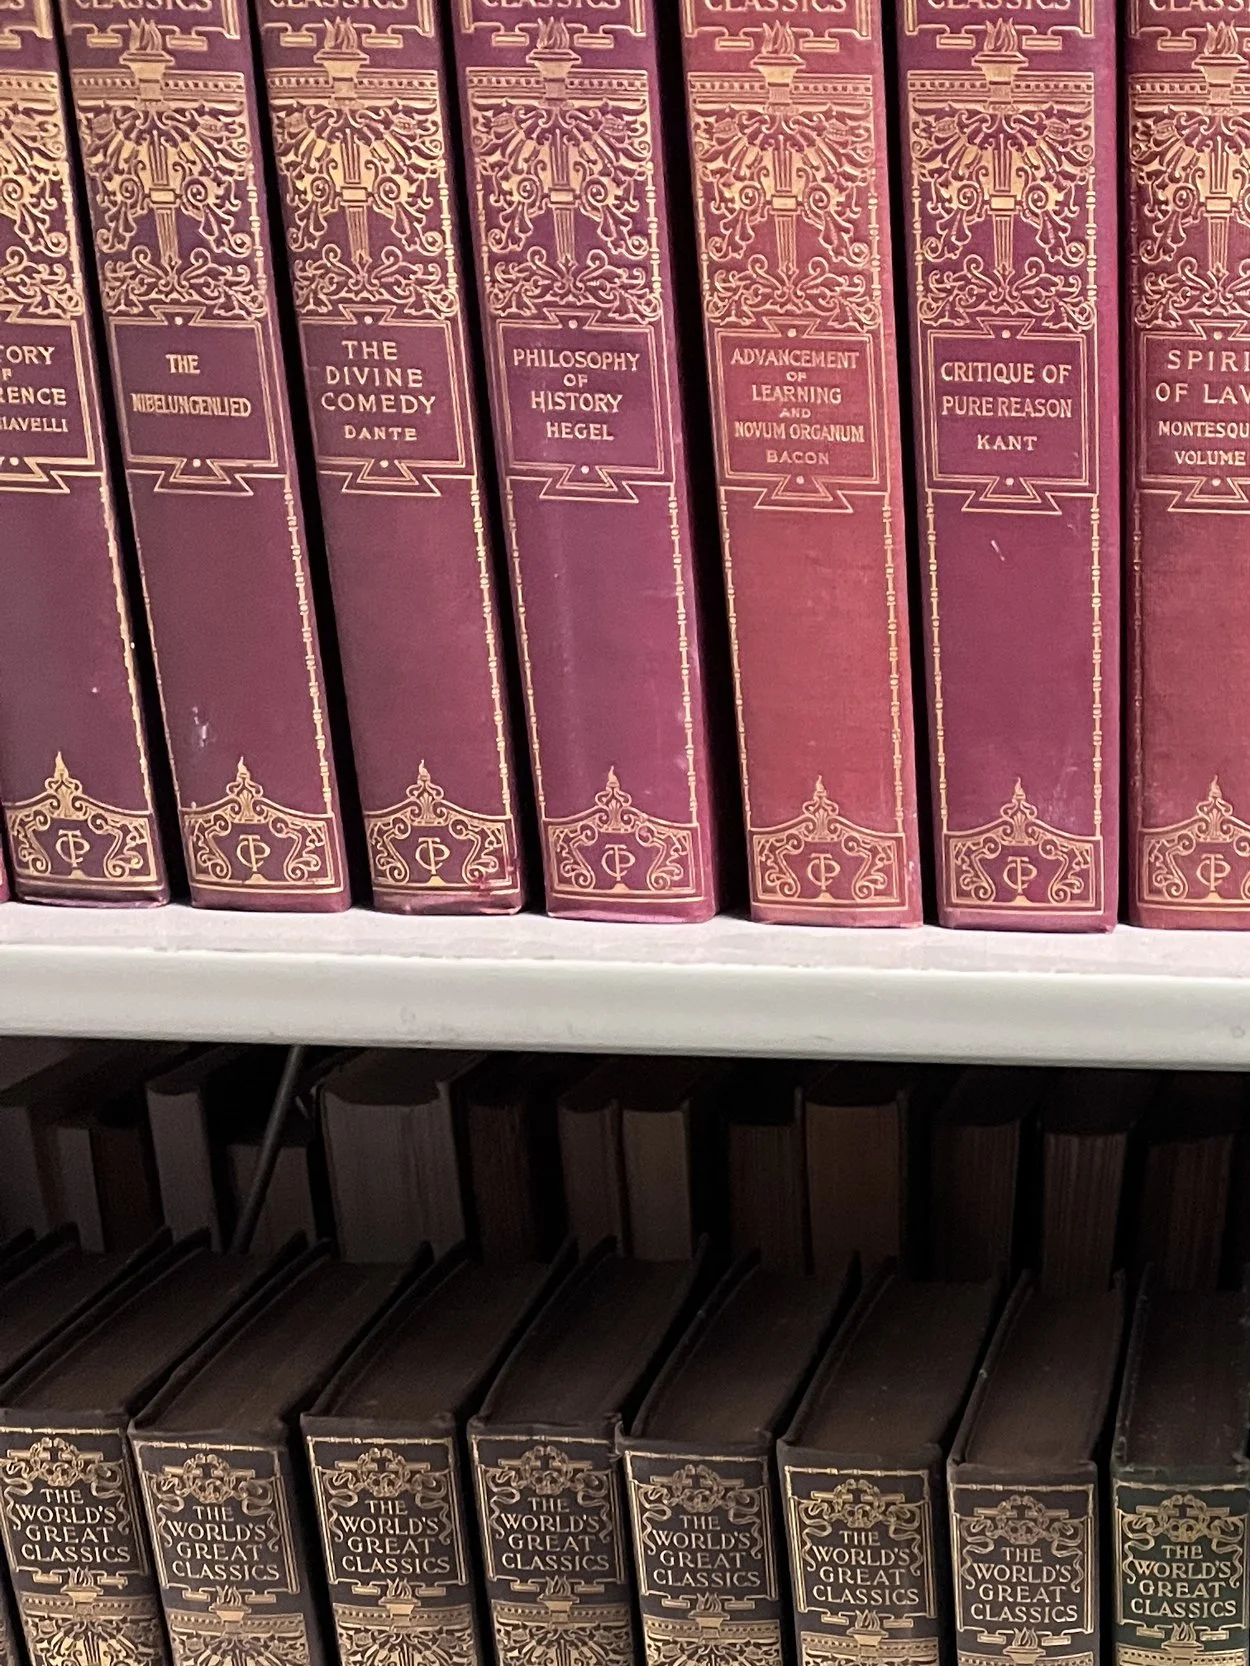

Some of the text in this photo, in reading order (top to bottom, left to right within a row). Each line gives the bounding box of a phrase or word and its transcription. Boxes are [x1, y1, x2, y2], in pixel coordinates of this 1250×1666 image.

[342, 340, 398, 361] THE
[513, 348, 641, 372] PHILOSOPHY
[731, 348, 859, 369] ADVANCEMENT
[166, 354, 200, 374] THE
[940, 361, 1072, 385] CRITIQUE OF
[326, 366, 423, 388] DIVINE
[563, 374, 588, 387] OF
[786, 371, 807, 382] OF
[531, 391, 623, 414] HISTORY
[751, 384, 842, 405] LEARNING
[1155, 382, 1188, 403] OF
[130, 392, 251, 417] NIBELUNGENLIED
[321, 392, 435, 414] COMEDY
[779, 407, 811, 419] AND
[941, 395, 1073, 418] PURE REASON
[344, 424, 418, 441] DANTE
[546, 422, 614, 441] HEGEL
[734, 422, 865, 444] NOVUM ORGANUM
[977, 435, 1037, 452] KANT
[766, 449, 829, 465] BACON
[1174, 450, 1245, 467] VOLUME
[40, 1489, 83, 1505] THE
[15, 1505, 117, 1525] WORLD'S
[25, 1526, 113, 1544] GREAT
[21, 1545, 131, 1563] CLASSICS
[1162, 1544, 1203, 1560] THE
[1134, 1559, 1231, 1579] WORLD'S
[1138, 1580, 1226, 1598] GREAT
[1131, 1599, 1236, 1617] CLASSICS
